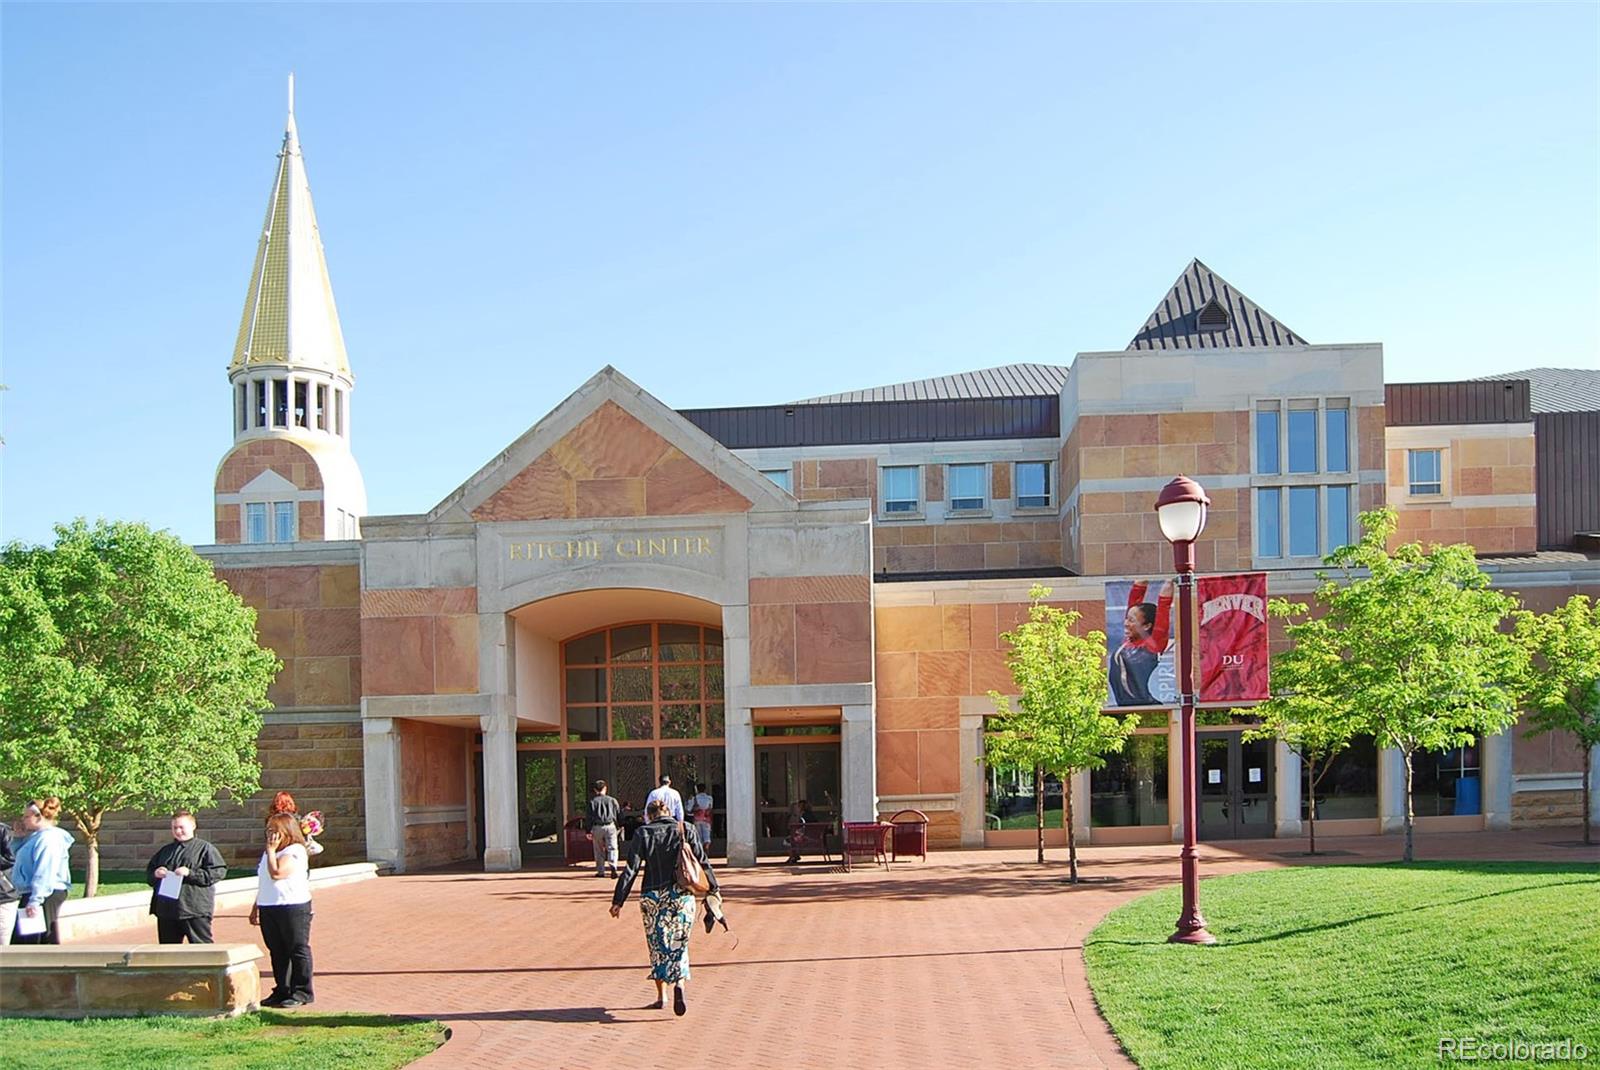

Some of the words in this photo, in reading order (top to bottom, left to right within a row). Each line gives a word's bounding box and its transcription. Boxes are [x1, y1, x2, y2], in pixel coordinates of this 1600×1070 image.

[509, 540, 600, 561] RITCHIE
[615, 536, 713, 558] CENTER
[1201, 594, 1265, 626] DENVER
[1222, 654, 1244, 665] DU
